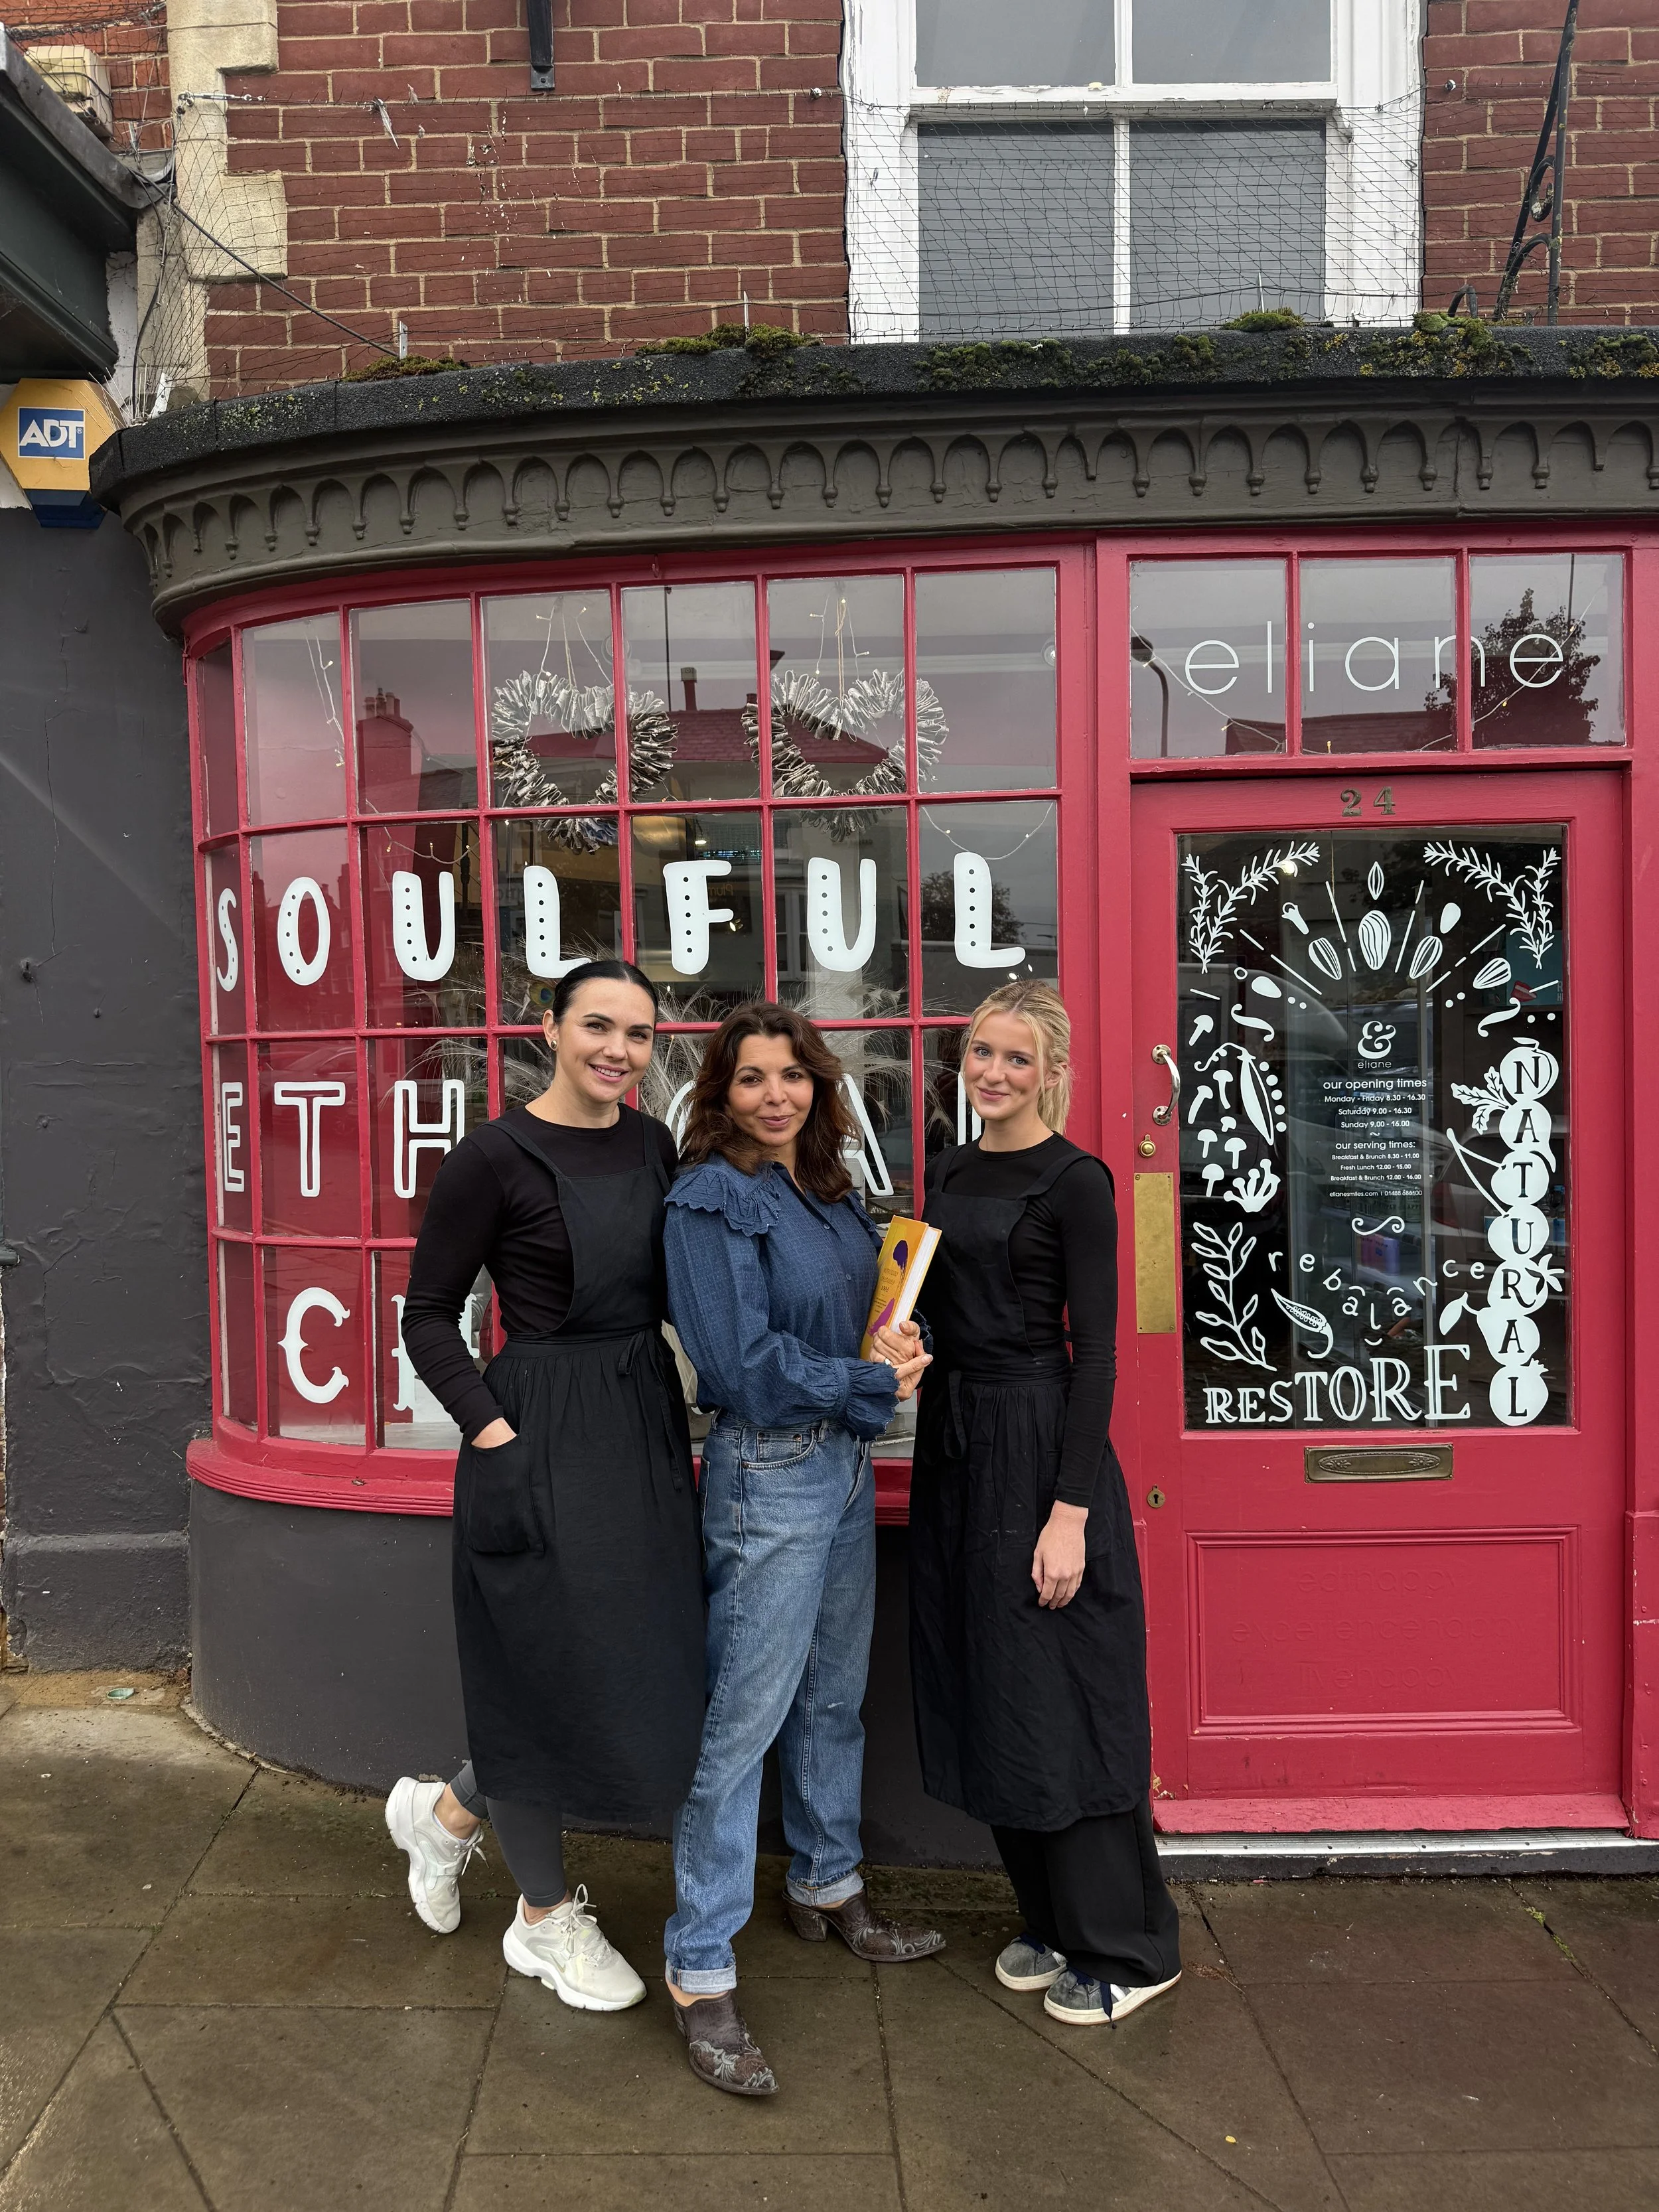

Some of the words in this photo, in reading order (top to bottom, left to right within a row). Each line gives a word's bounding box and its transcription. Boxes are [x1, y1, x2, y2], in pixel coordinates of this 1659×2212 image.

[1185, 621, 1564, 696] eliane
[1340, 786, 1396, 817] 24
[216, 852, 1026, 993] SOULFUL
[1357, 1020, 1396, 1059] &
[1323, 1081, 1342, 1090] our
[1345, 1079, 1394, 1090] opening
[1396, 1078, 1427, 1088] times
[1353, 1141, 1386, 1151] serving
[1498, 1056, 1542, 1417] NATURAL
[1268, 1250, 1484, 1331] rebalance
[1202, 1344, 1471, 1424] RESTORE
